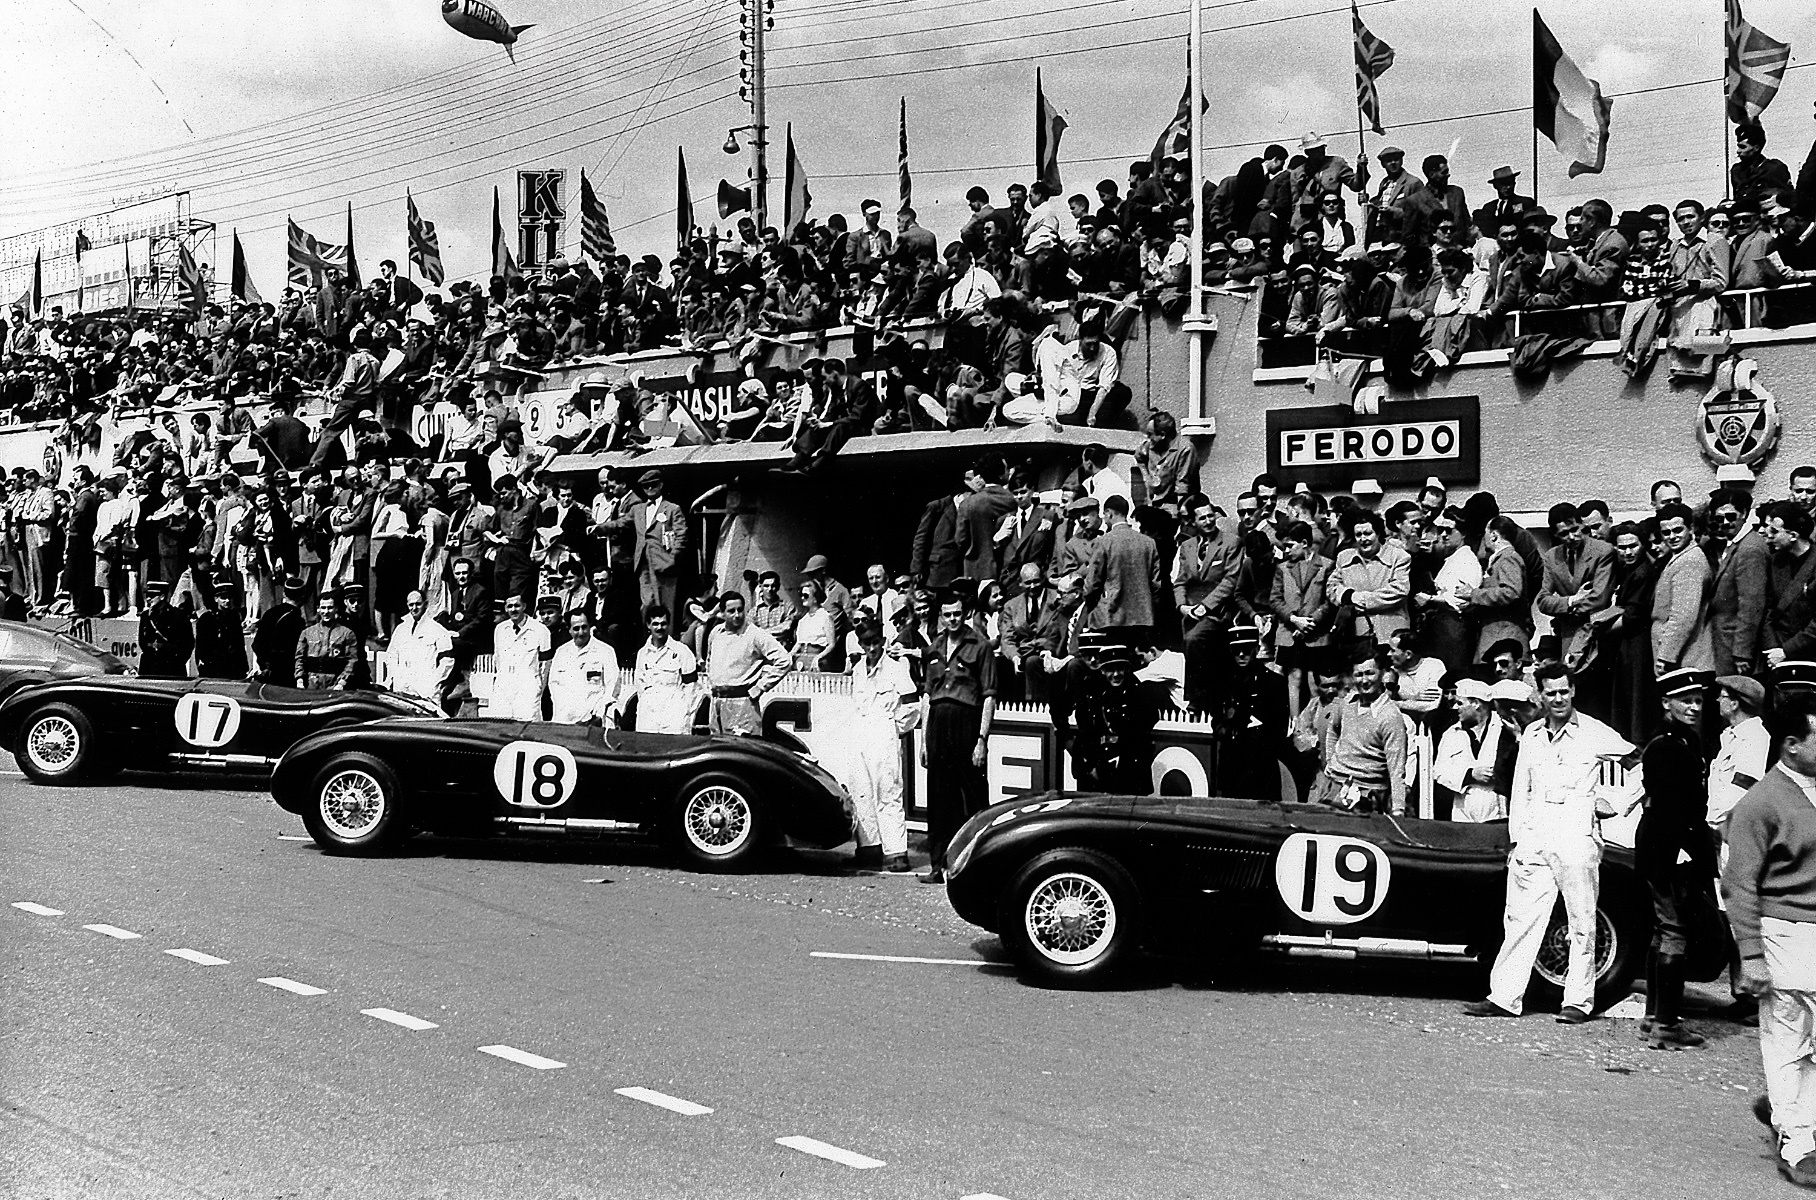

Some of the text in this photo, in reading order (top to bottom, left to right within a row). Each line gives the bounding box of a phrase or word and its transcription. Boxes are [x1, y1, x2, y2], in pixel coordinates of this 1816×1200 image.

[1286, 425, 1455, 462] FERODO
[111, 641, 138, 657] avec
[189, 700, 231, 742] 17
[512, 751, 565, 806] 18
[1301, 840, 1377, 916] 19
